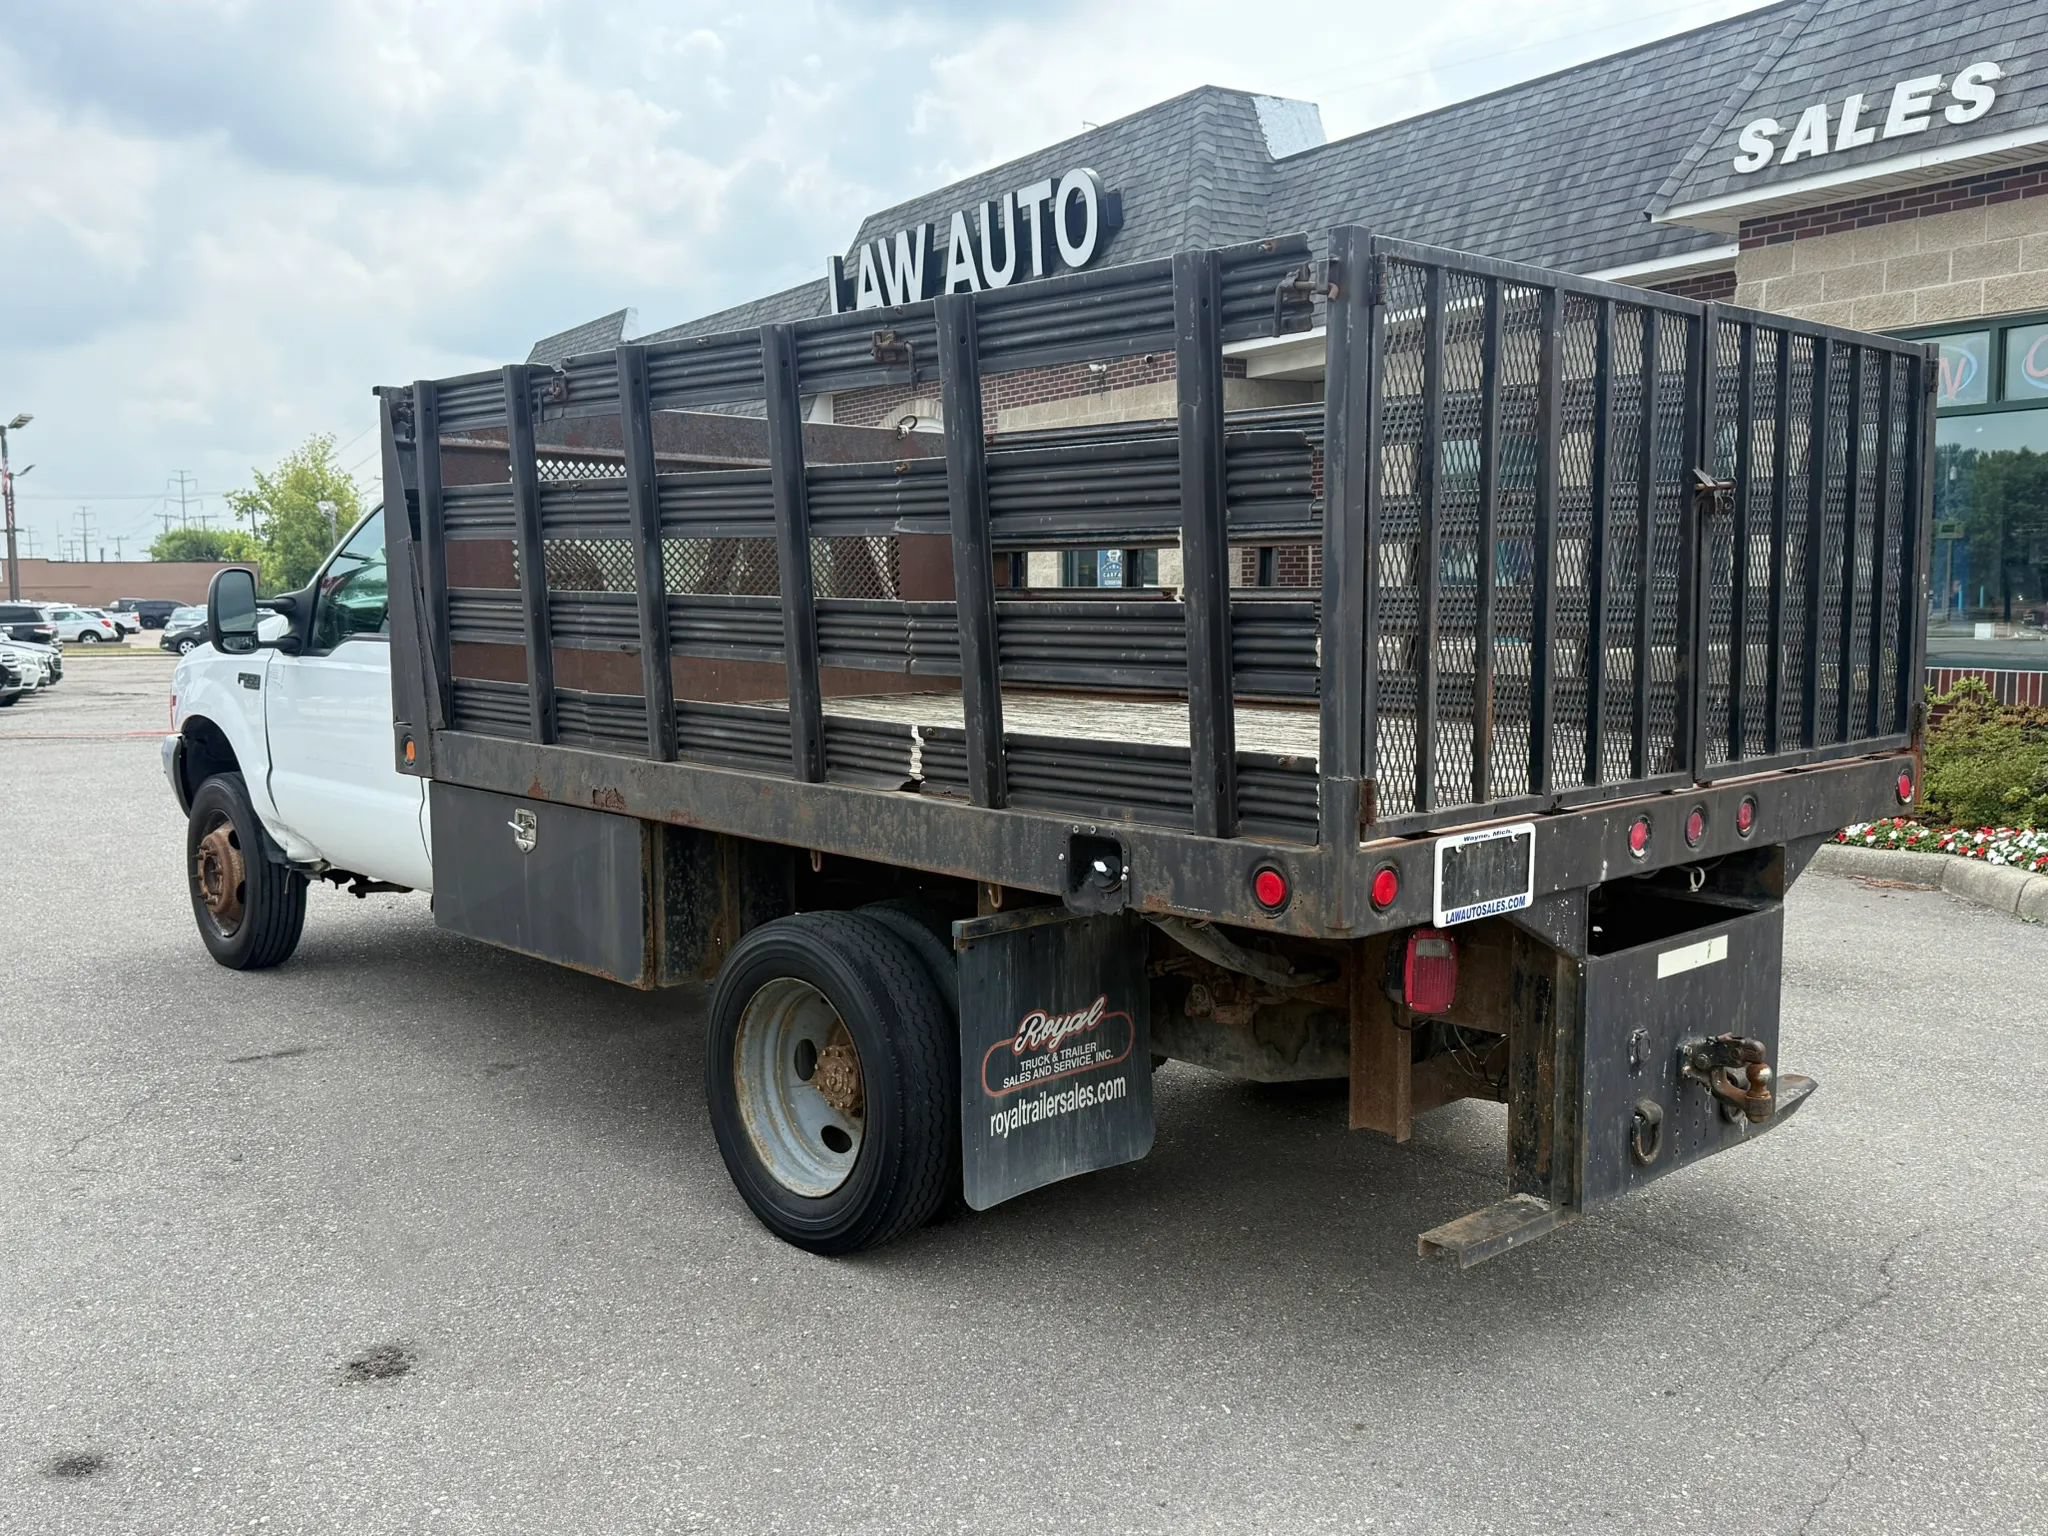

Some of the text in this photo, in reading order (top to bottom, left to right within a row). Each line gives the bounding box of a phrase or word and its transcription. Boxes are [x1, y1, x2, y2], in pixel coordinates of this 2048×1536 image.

[1733, 61, 2001, 174] SALES
[827, 167, 1104, 314] LAW AUTO
[1445, 895, 1526, 925] LAWAUTOSALES.COM
[1014, 996, 1106, 1050] Royal
[1003, 1049, 1114, 1089] SALES AND SERVICE, INC.
[1020, 1042, 1097, 1072] TRUCK & TRAILER
[990, 1075, 1126, 1138] royaltrailersales.com
